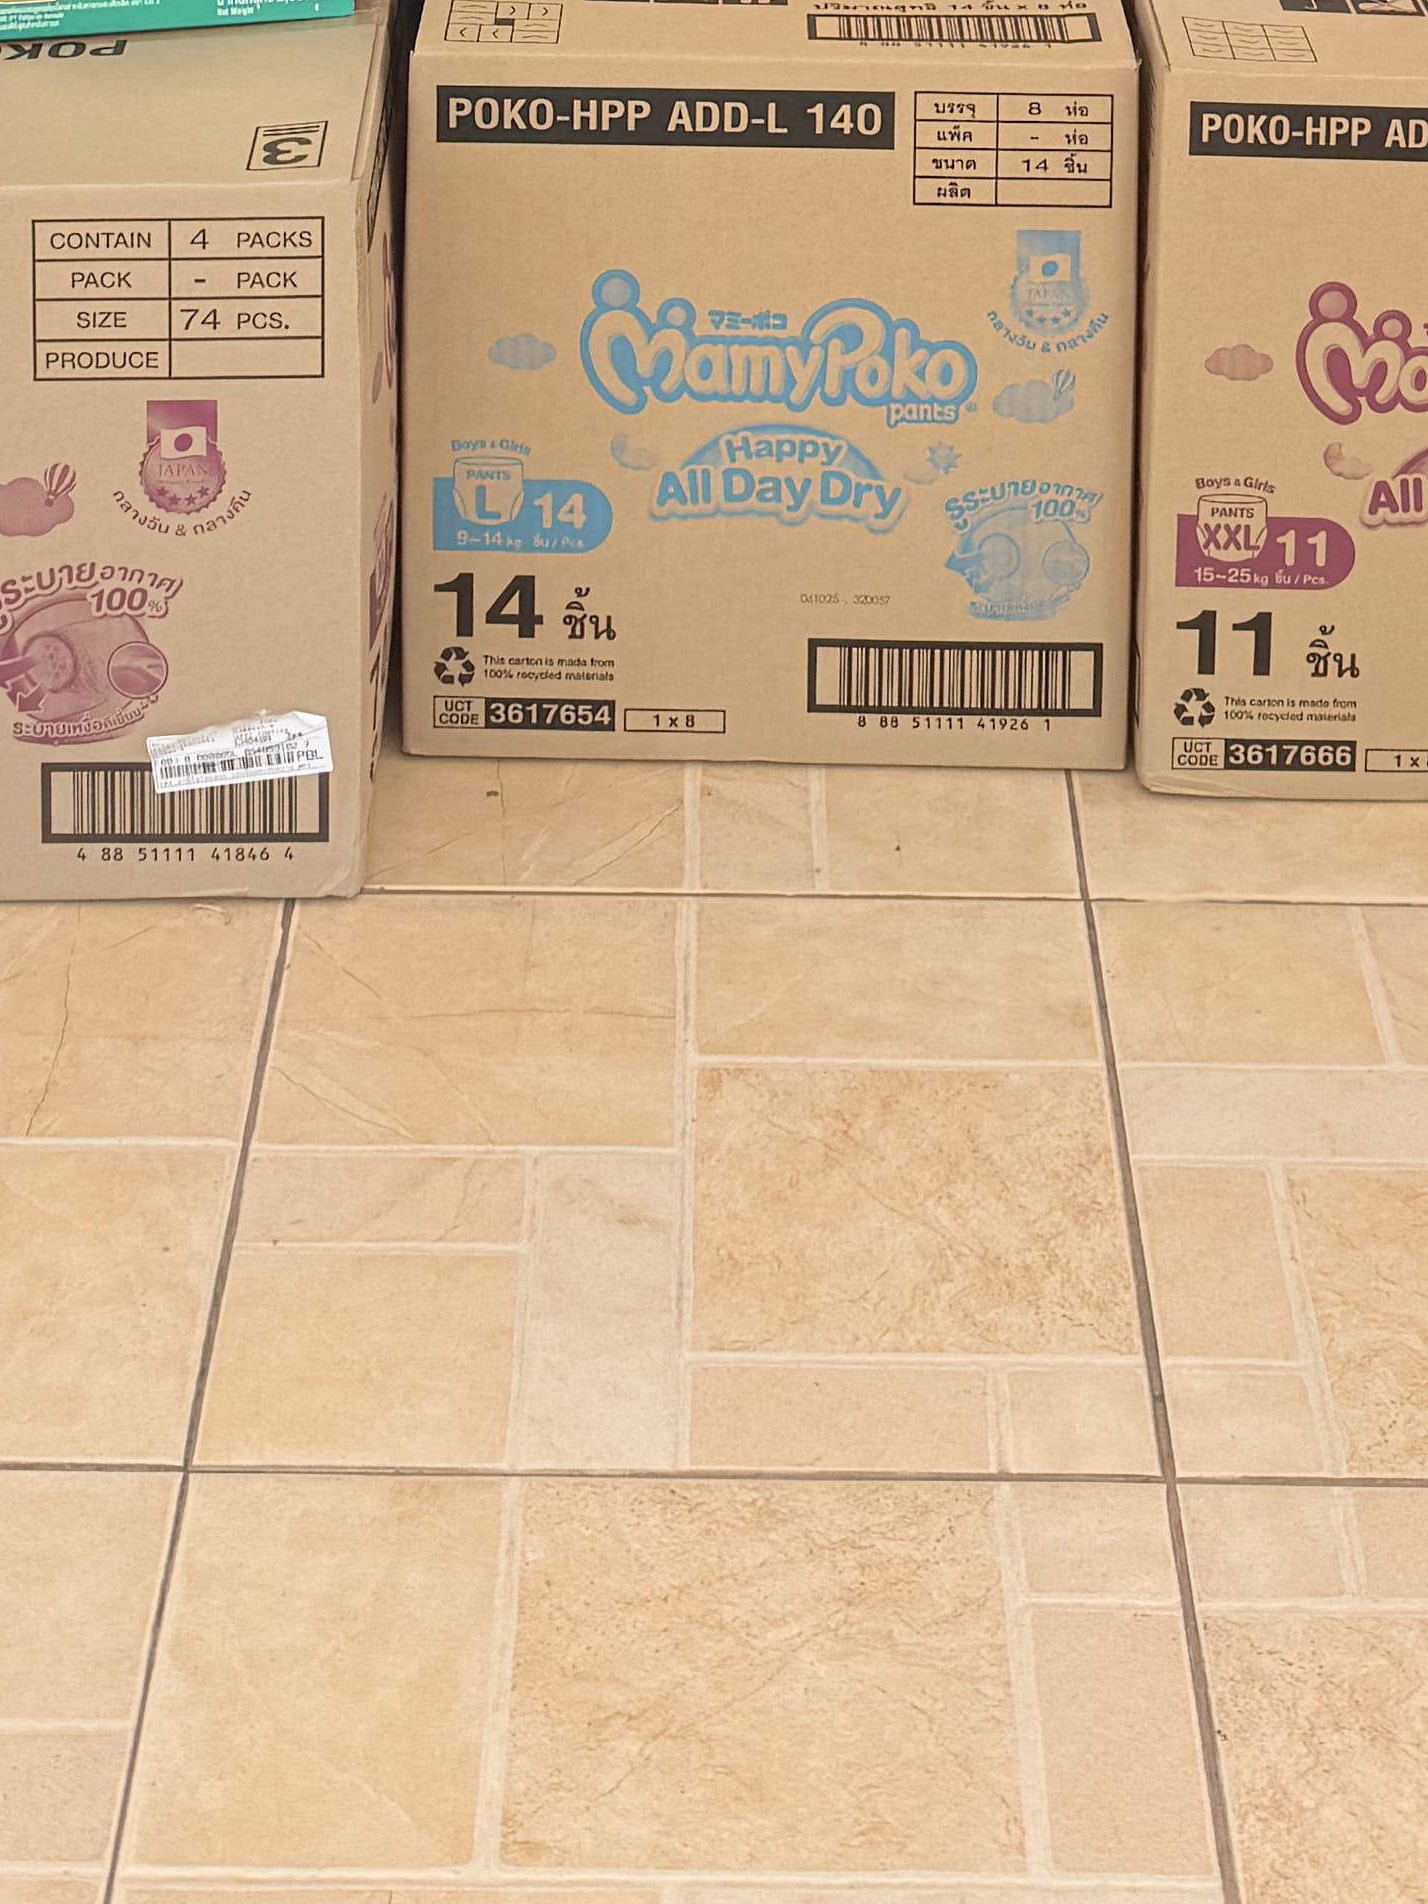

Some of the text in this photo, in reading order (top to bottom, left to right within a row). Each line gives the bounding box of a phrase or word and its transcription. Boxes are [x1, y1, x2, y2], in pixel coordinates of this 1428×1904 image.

[446, 97, 884, 138] POKO-HPP ADD-L 140
[1200, 113, 1371, 148] POKO-HPP
[48, 227, 313, 250] CONTAIN 4 PACKS
[44, 349, 160, 371] PRODUCE
[112, 488, 170, 537] กลางวัน
[192, 487, 253, 537] กลางคืน
[433, 572, 617, 642] 14 ชิ้น
[489, 701, 611, 725] 3617654
[1229, 743, 1352, 767] 3617666
[137, 845, 270, 862] 51111 41846
